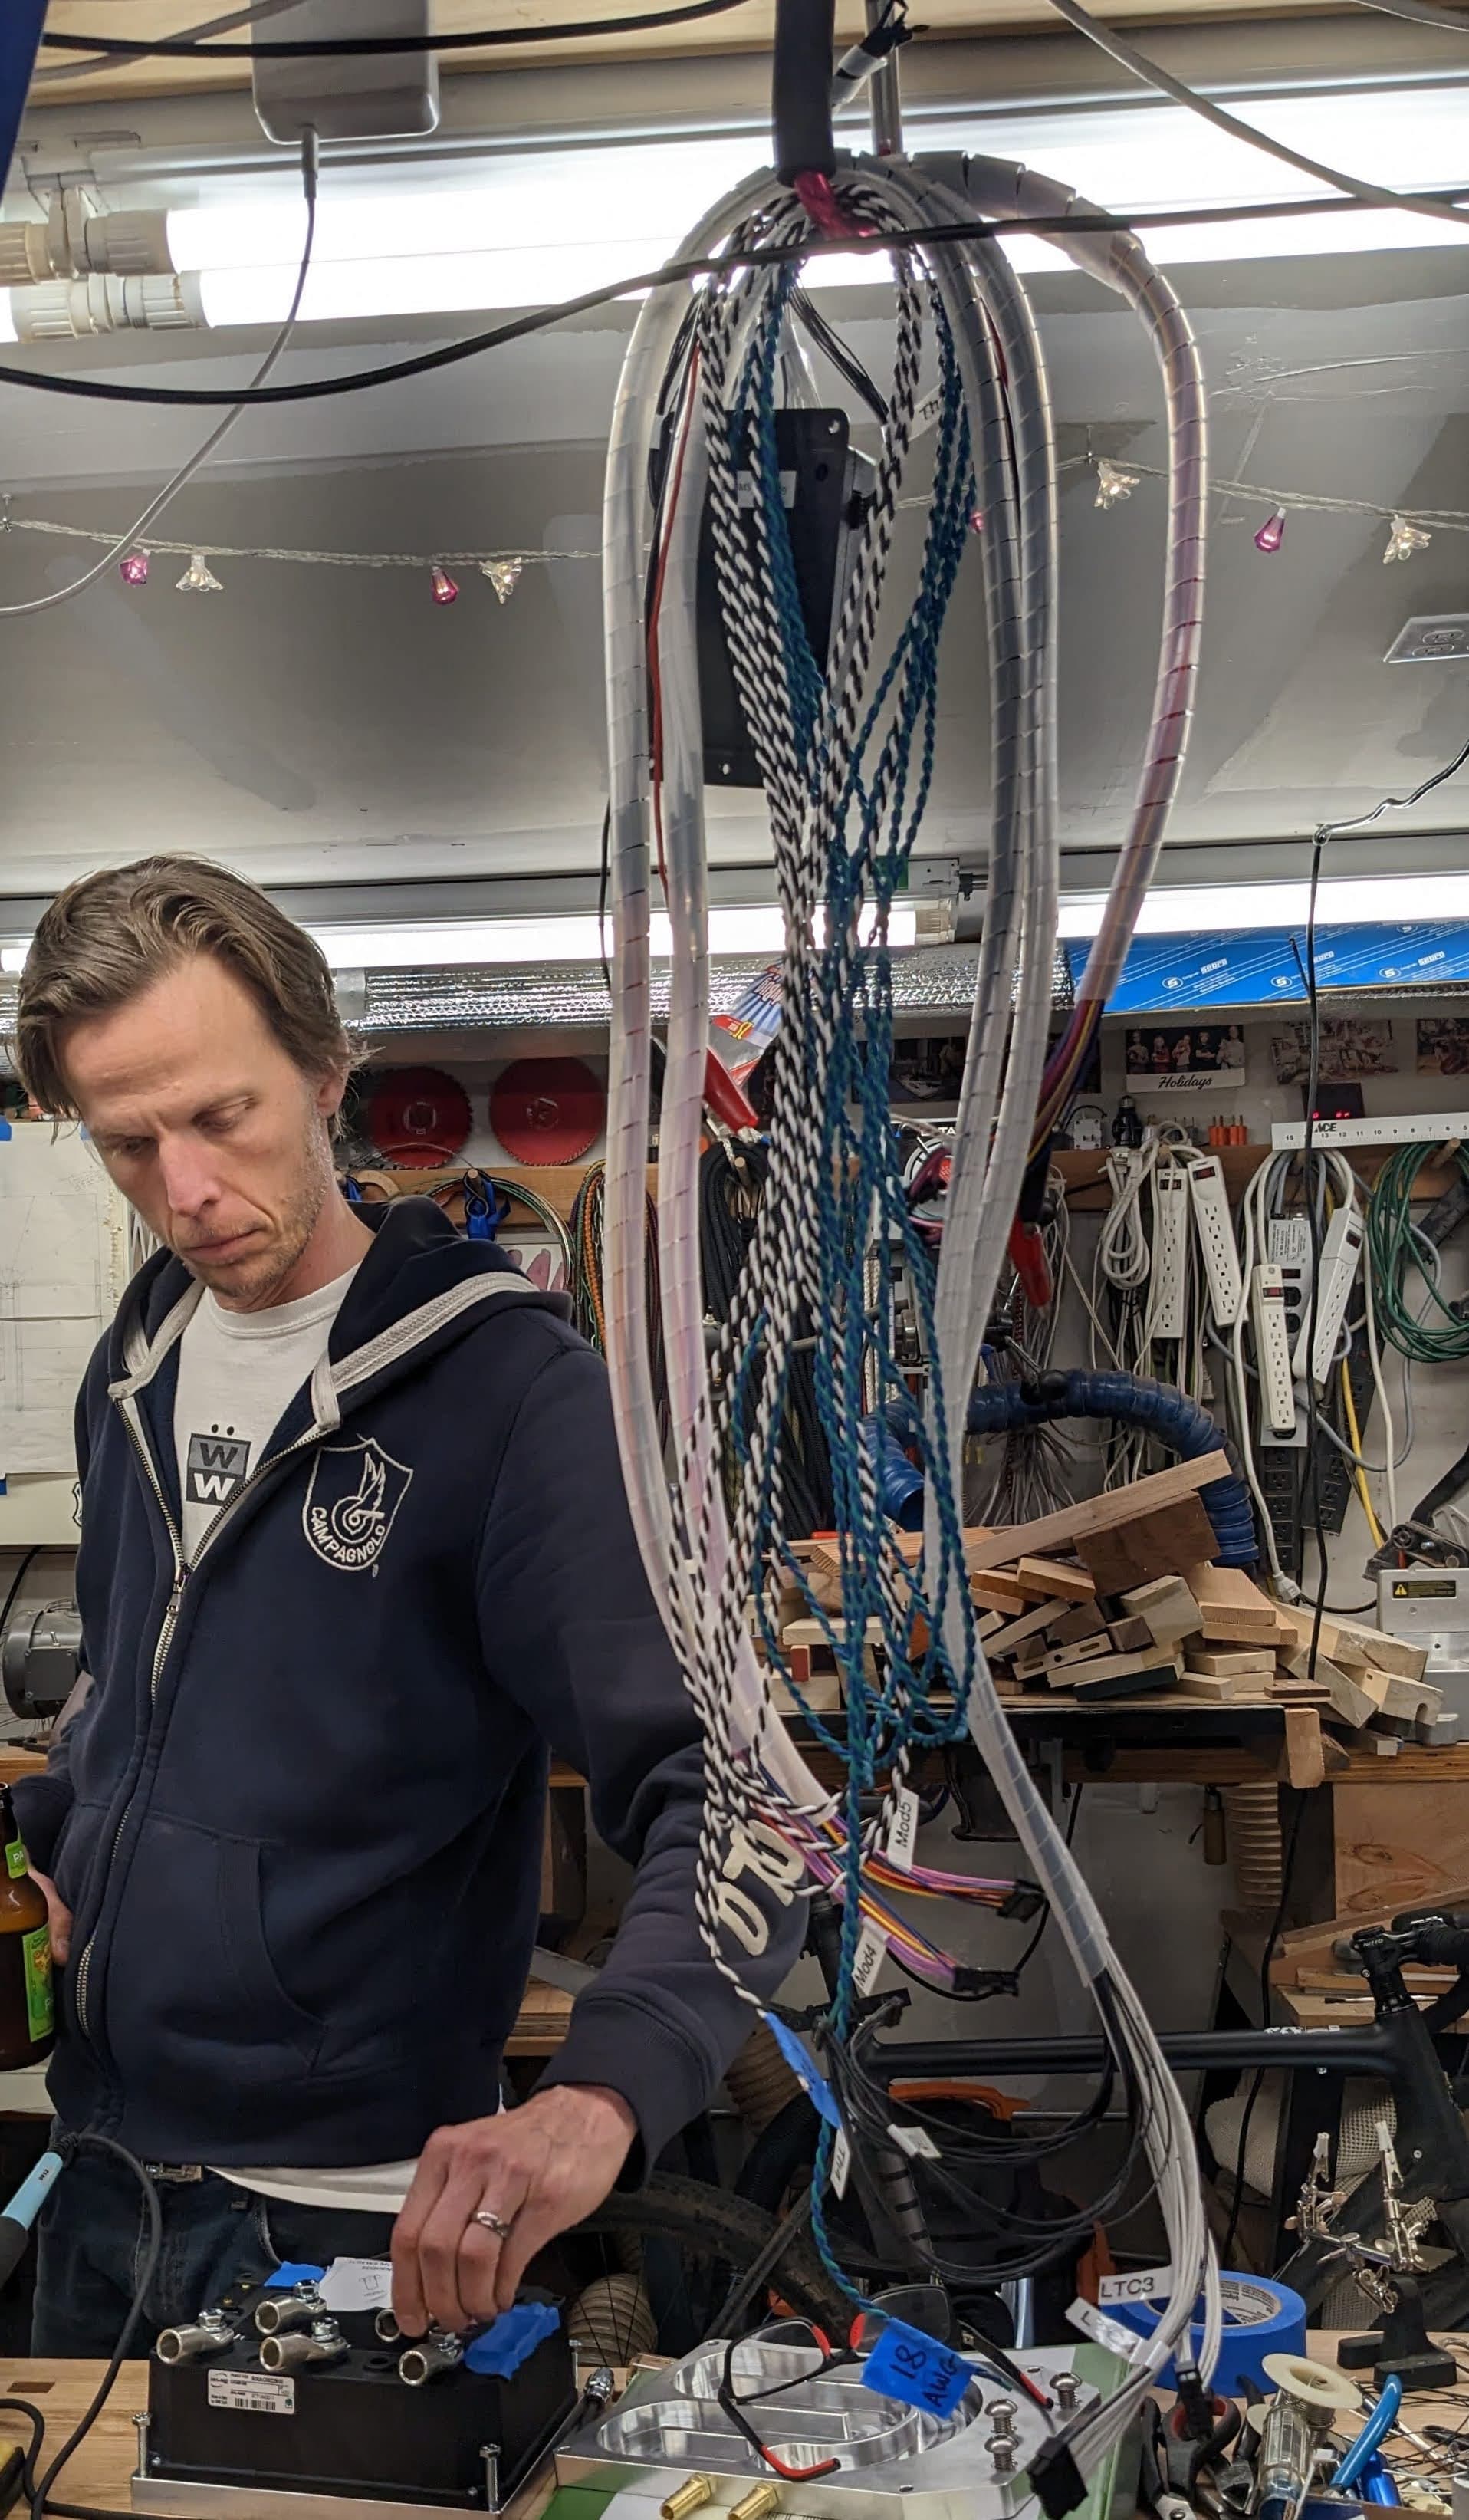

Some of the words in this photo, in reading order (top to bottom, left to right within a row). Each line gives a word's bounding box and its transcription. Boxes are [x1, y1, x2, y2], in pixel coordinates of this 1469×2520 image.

[1158, 1074, 1212, 1090] Holidays
[1314, 1123, 1336, 1133] ACE
[311, 1506, 385, 1564] CAMPAGNOLO
[895, 1799, 912, 1849] Mod5
[854, 1944, 877, 1988] Mod4
[1101, 2276, 1155, 2298] LTC3
[889, 2344, 927, 2380] 18
[922, 2354, 958, 2408] AWG
